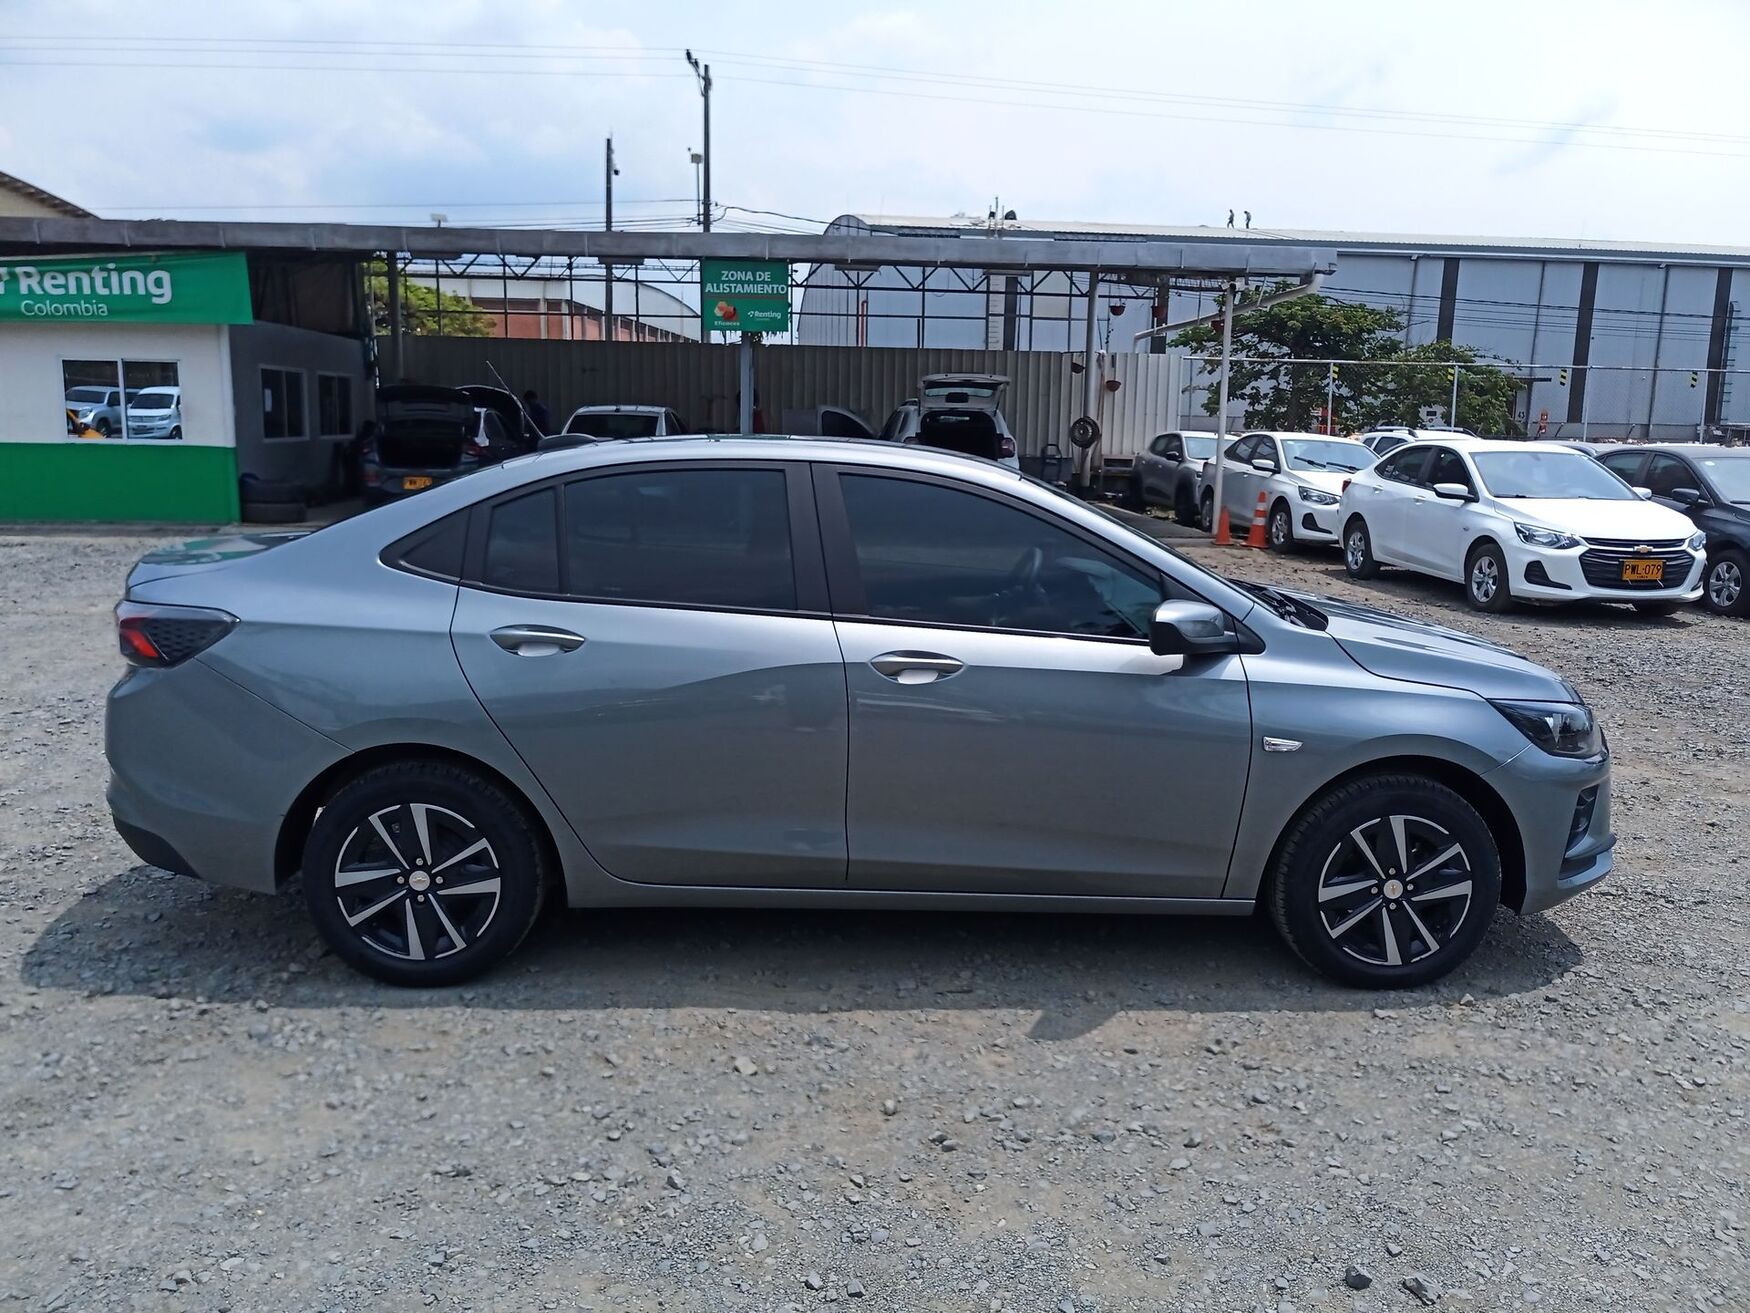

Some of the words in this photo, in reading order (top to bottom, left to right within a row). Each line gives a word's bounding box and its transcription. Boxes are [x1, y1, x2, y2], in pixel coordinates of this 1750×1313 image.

[721, 270, 753, 281] ZONA
[756, 271, 771, 281] DE
[15, 262, 173, 305] Renting
[705, 283, 787, 294] ALISTAMIENTO
[20, 299, 109, 316] Colombia
[754, 310, 782, 319] Renting
